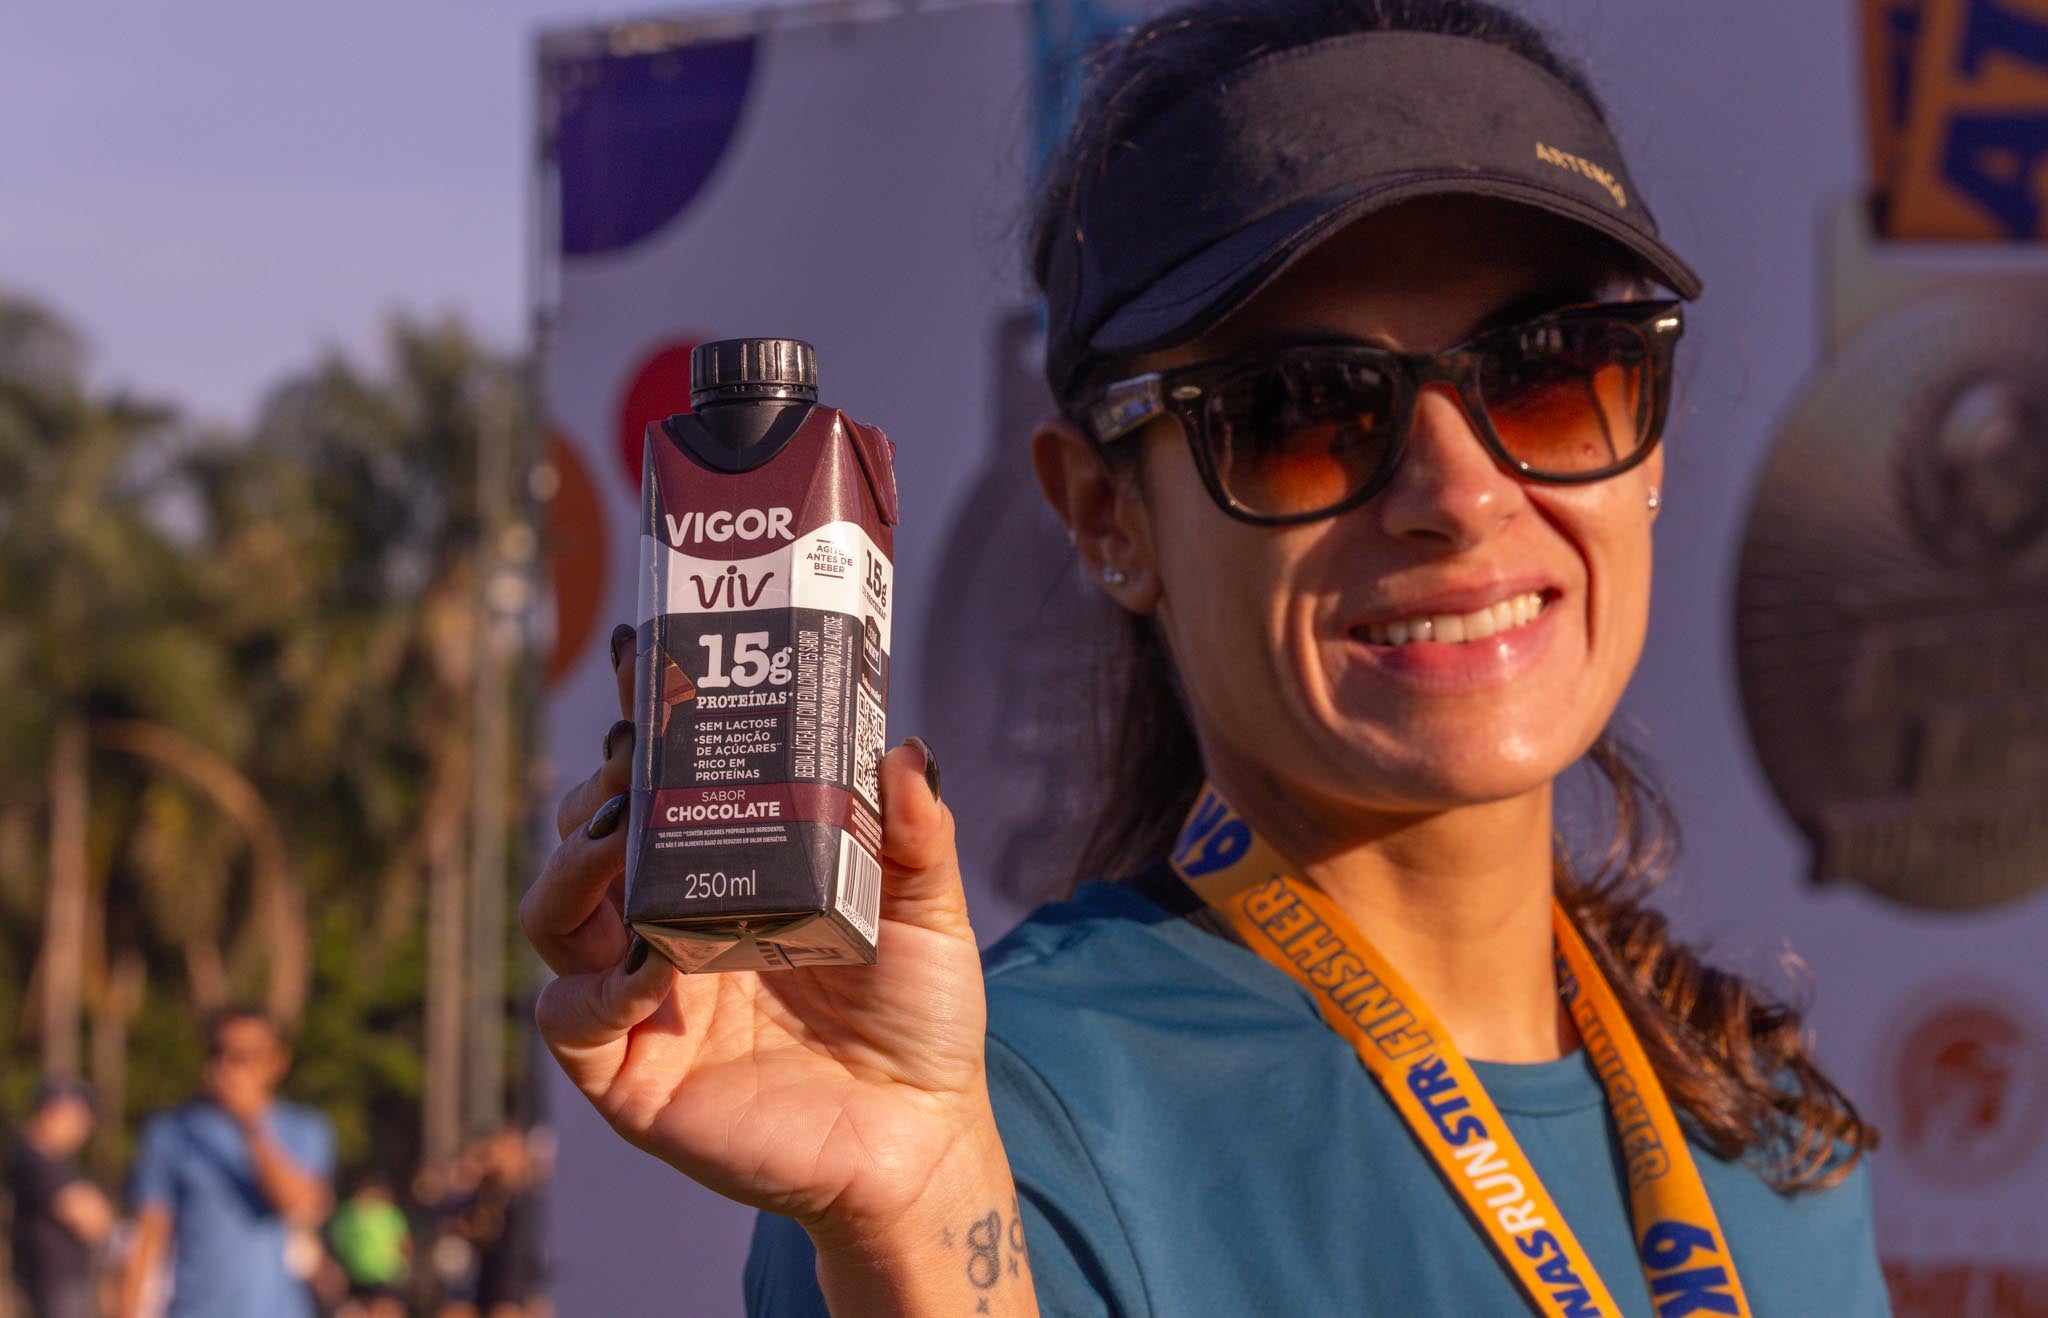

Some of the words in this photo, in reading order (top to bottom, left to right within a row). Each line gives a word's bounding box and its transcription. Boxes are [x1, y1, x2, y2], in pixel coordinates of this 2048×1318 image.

[665, 507, 796, 547] VIGOR
[806, 552, 838, 564] ANTES
[840, 556, 853, 566] DE
[814, 562, 845, 573] BEBER
[865, 548, 888, 608] 15g
[798, 630, 819, 651] SABOR
[823, 615, 843, 645] LACTOSE
[697, 631, 793, 688] 15g
[823, 644, 842, 654] DE
[797, 652, 818, 701] EDULCORANTES
[820, 654, 846, 689] RESTRIÇÃO
[821, 688, 841, 704] COM
[796, 701, 817, 716] COM
[821, 704, 840, 728] DIETAS
[699, 722, 723, 731] SEM
[726, 718, 778, 730] LACTOSE
[796, 716, 817, 730] UHT
[699, 735, 722, 744] SEM
[725, 730, 770, 744] ADIÇÃO
[791, 731, 816, 754] LÁCTEA
[821, 727, 839, 743] PARA
[696, 746, 712, 756] DE
[698, 759, 726, 769] RICO
[729, 758, 745, 768] EM
[795, 755, 816, 778] BEBIDA
[820, 743, 838, 781] CHOCOLATE
[696, 768, 760, 781] PROTEÍNAS
[701, 789, 746, 802] SABOR
[666, 801, 780, 823] CHOCOLATE
[1243, 873, 1435, 1061] FINISHER
[1642, 1221, 1740, 1318] 6K
